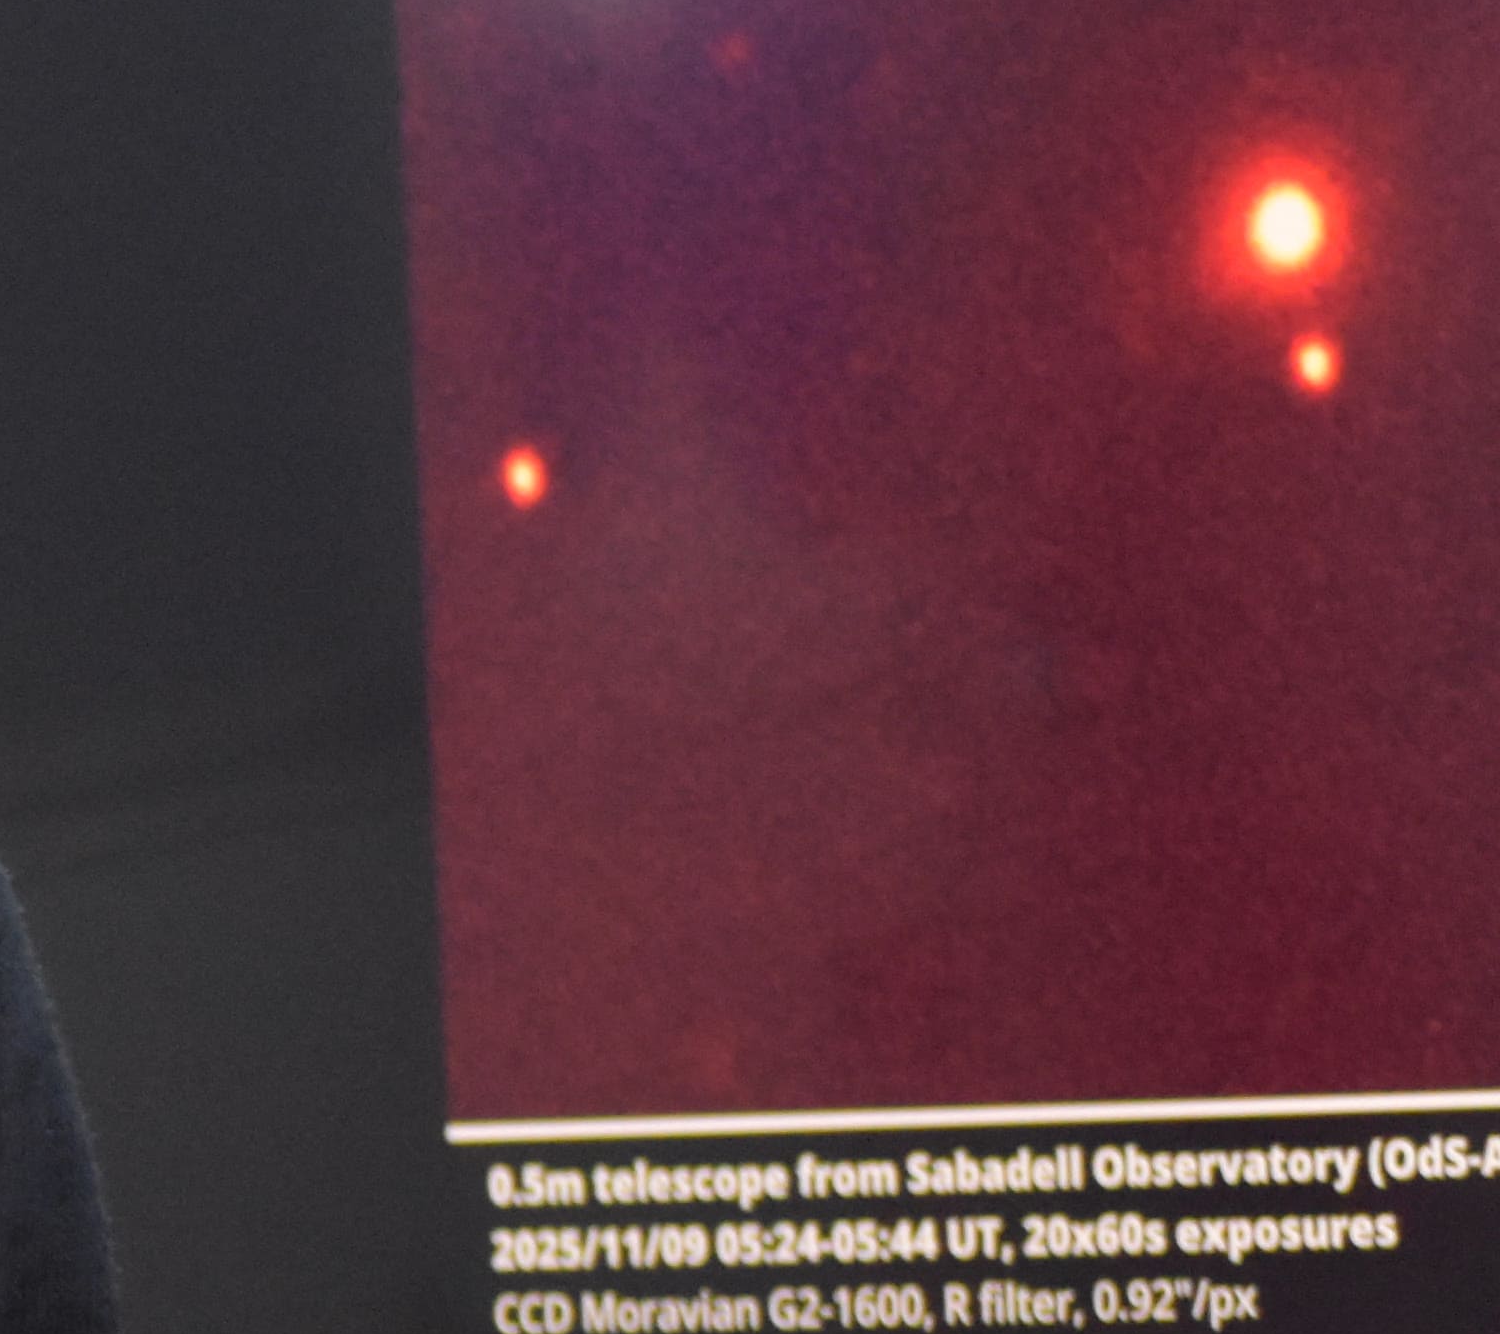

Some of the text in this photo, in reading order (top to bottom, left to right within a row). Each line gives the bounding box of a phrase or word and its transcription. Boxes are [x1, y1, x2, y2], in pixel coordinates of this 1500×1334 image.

[488, 1162, 588, 1208] 0.5m
[592, 1156, 790, 1212] telescope
[797, 1151, 899, 1198] from
[904, 1145, 1086, 1195] Sabadell
[1092, 1142, 1360, 1194] Observatory
[490, 1210, 1401, 1273] 2025/11/09 05:24-05:44 UT, 20x60s exposures
[579, 1286, 763, 1334] Moravian
[768, 1282, 936, 1334] G2-1600,
[942, 1281, 975, 1328] R
[978, 1277, 1087, 1330] filter,
[1092, 1277, 1262, 1333] 0.92"/px
